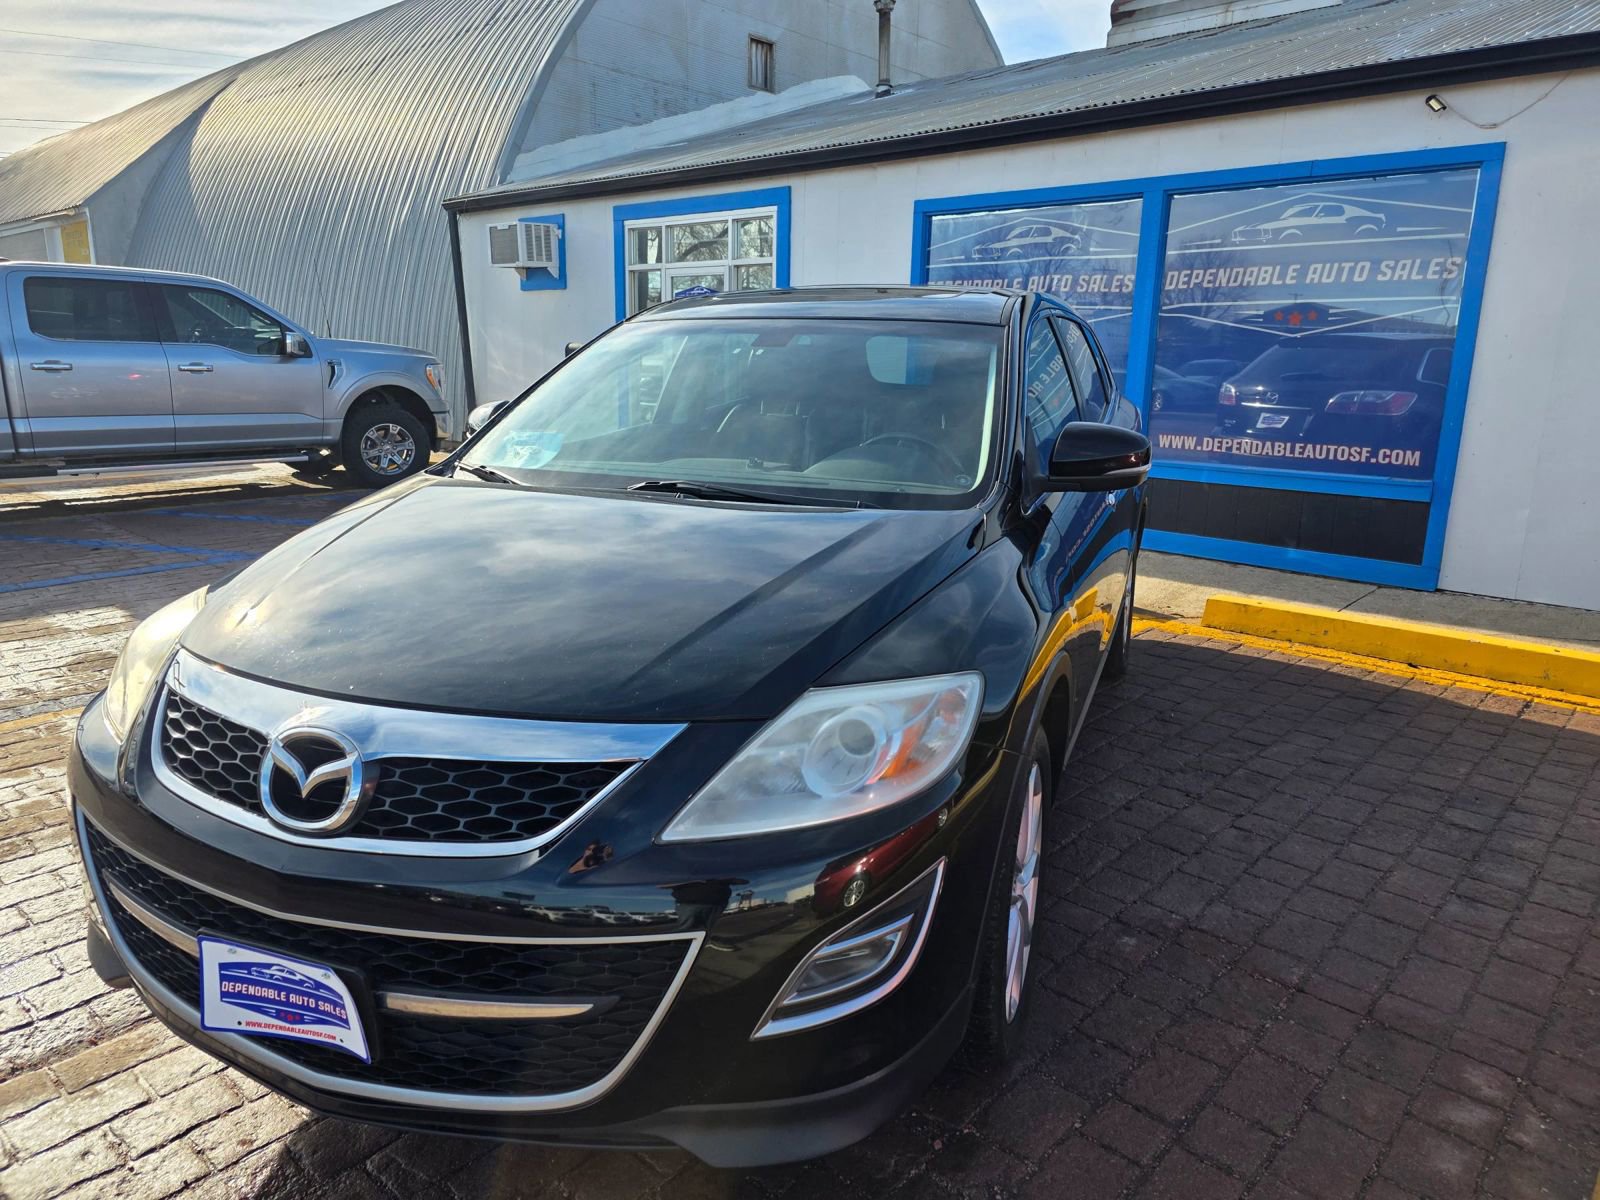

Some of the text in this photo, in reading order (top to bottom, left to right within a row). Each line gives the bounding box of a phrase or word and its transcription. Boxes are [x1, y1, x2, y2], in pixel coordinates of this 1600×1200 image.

[1027, 275, 1072, 292] AUTO
[1077, 274, 1135, 293] SALES
[1164, 256, 1463, 291] DEPENDABLE AUTO SALES
[1158, 433, 1421, 467] WWW.DEPENDABLEAUTOSF.COM
[221, 981, 347, 1020] DEPENDABLE AUTO SALES
[245, 1019, 337, 1041] WWW.DEPENDABLEAUTOSF.COM
